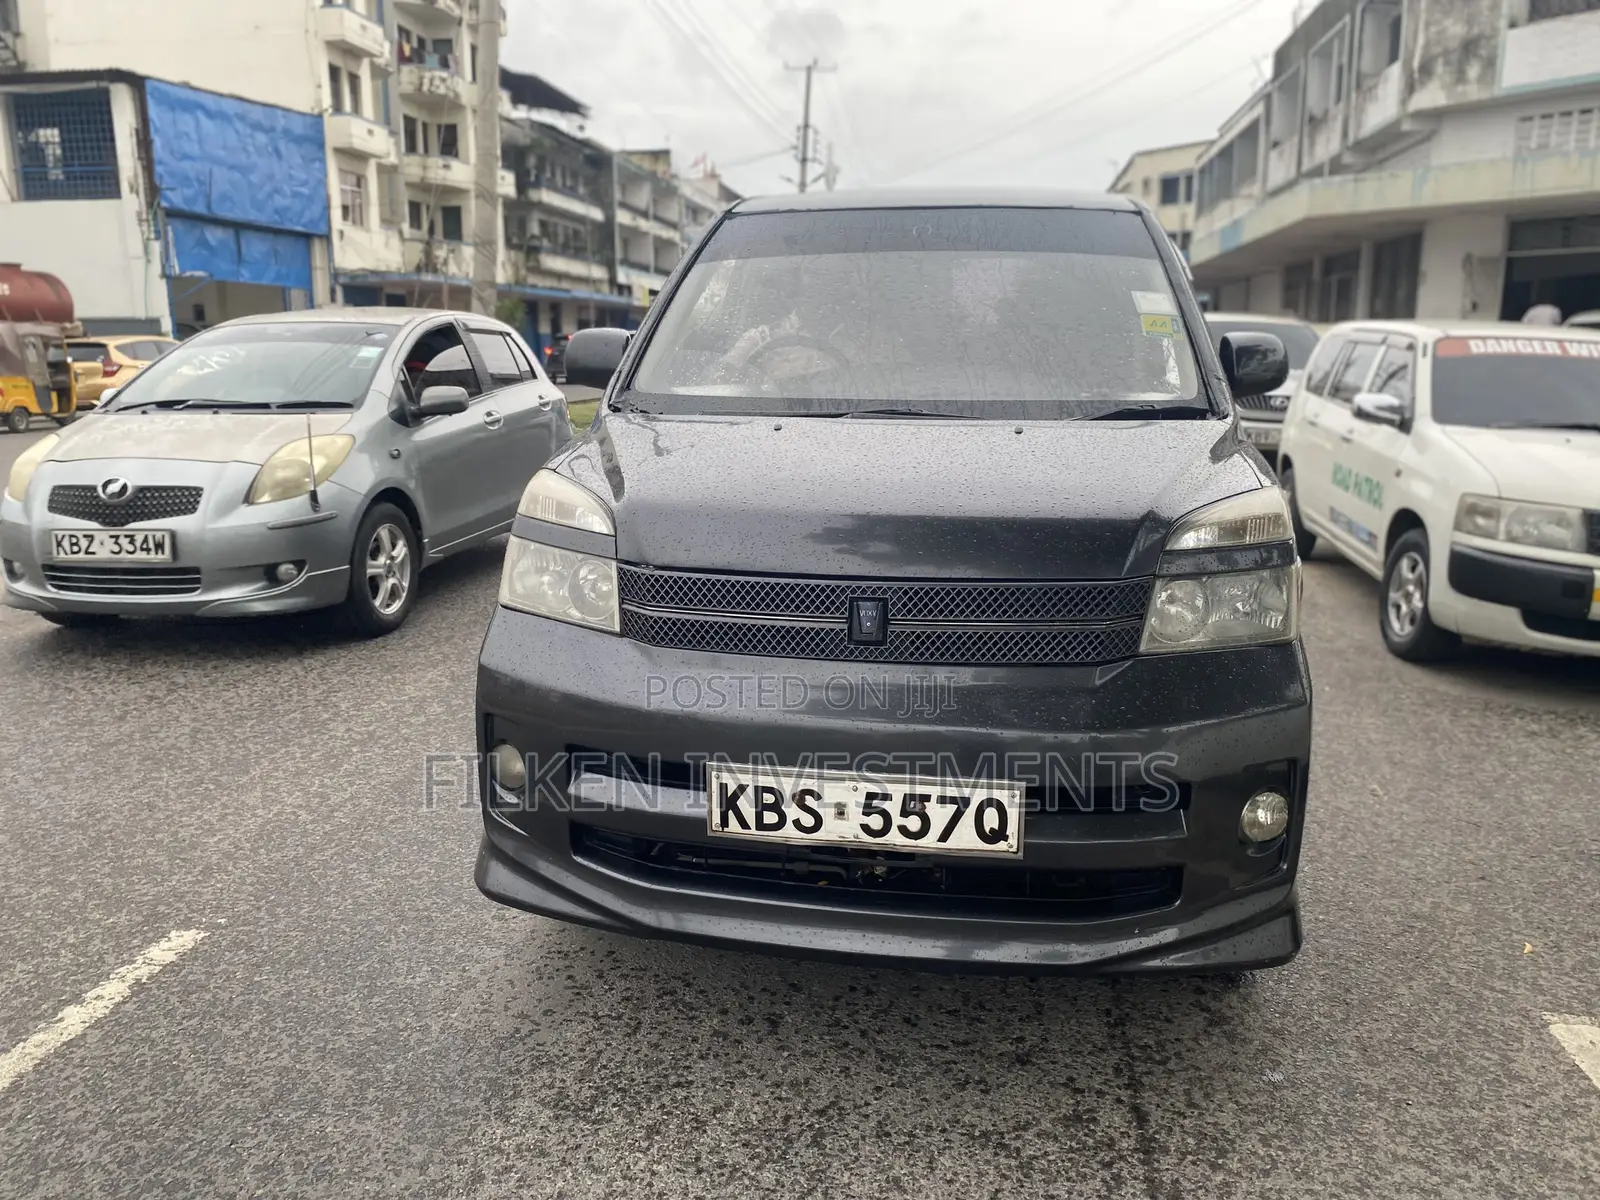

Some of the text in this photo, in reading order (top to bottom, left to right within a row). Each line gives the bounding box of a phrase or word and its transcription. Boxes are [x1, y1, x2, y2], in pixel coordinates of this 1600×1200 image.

[1467, 338, 1600, 358] DANGER WI
[1352, 471, 1385, 512] PATROL
[54, 533, 166, 556] KBZ 334W
[718, 780, 1011, 846] KBS 557Q
